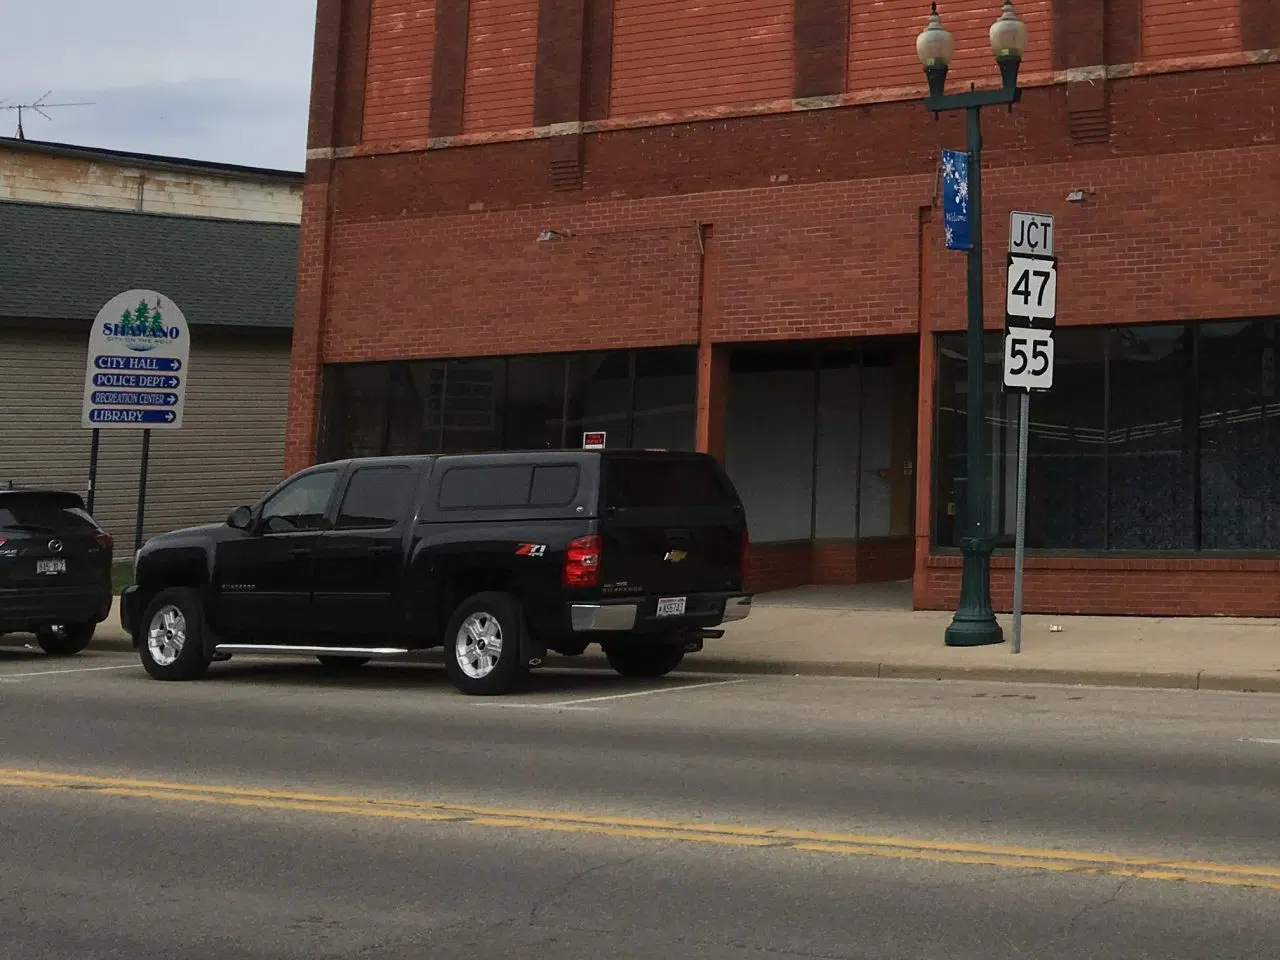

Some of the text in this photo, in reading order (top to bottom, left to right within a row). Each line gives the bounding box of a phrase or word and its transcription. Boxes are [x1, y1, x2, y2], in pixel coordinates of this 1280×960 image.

[1013, 219, 1051, 250] JCT
[1011, 269, 1051, 307] 47
[102, 322, 180, 339] SHAWANO
[99, 356, 159, 370] CITY HALL
[1009, 338, 1050, 377] 55
[97, 374, 168, 387] POLICE DEPT.
[94, 392, 164, 405] RECREATION CENTER
[93, 410, 144, 422] LIBRARY
[515, 543, 547, 556] Z71
